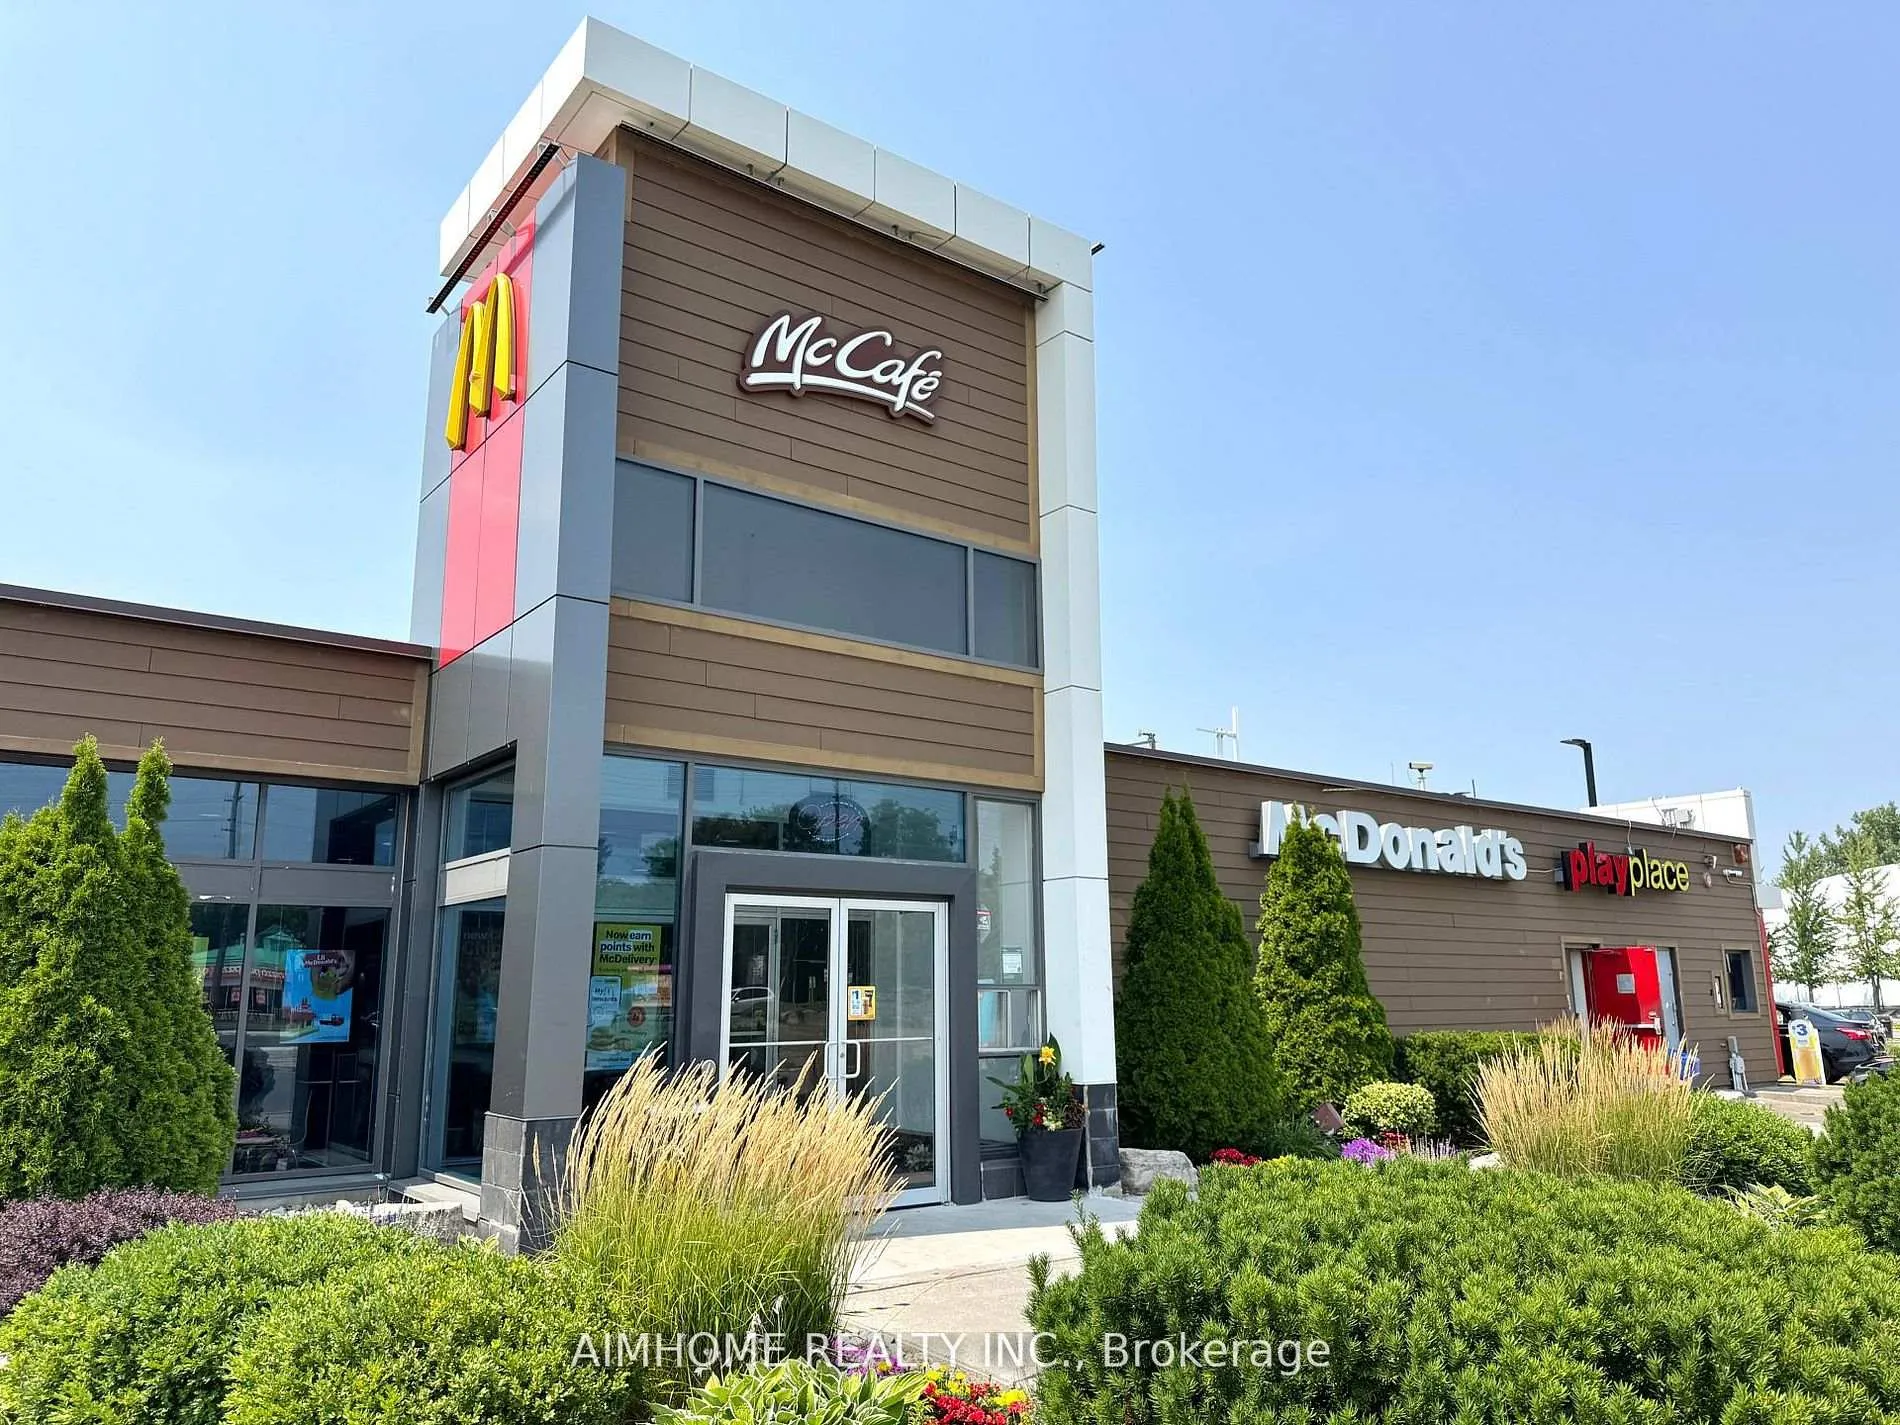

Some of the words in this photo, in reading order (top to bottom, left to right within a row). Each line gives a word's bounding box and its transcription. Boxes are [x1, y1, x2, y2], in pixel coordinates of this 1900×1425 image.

[750, 314, 943, 412] McCafé
[605, 929, 629, 939] Now
[629, 931, 652, 940] earn
[600, 941, 633, 953] points
[633, 942, 655, 952] with
[599, 953, 657, 965] McDelivery
